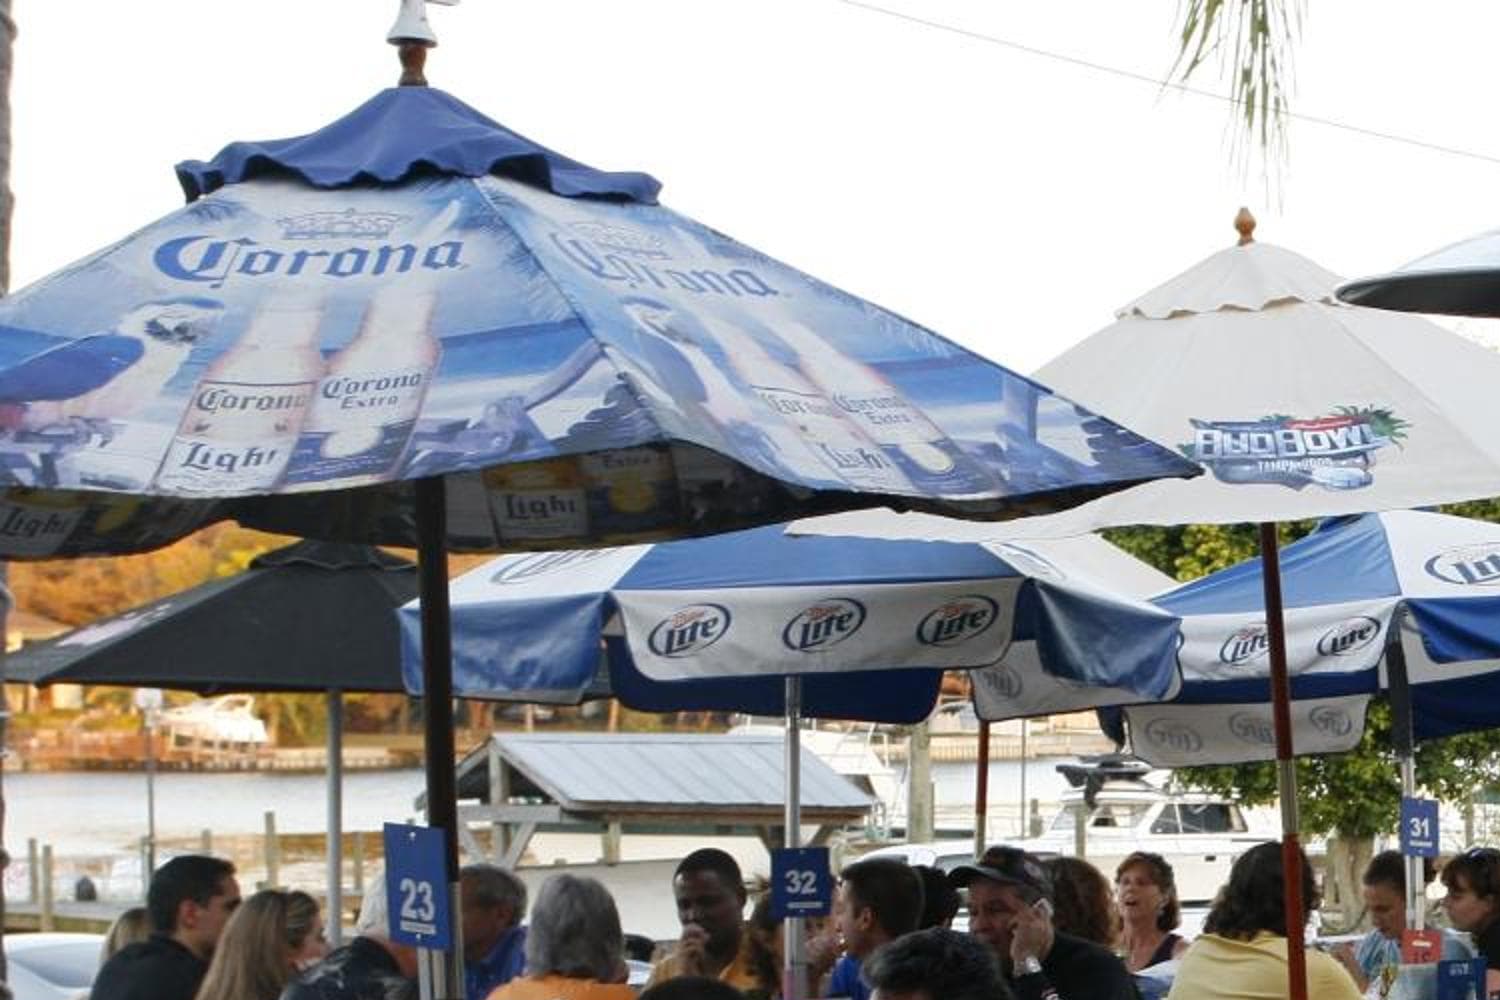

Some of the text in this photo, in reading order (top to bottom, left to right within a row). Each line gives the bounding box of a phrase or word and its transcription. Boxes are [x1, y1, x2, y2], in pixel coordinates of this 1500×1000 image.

[153, 234, 466, 288] Corona
[321, 373, 422, 400] Corona
[181, 441, 276, 472] Light
[664, 617, 719, 655] Lite
[800, 612, 854, 649] Lite
[933, 610, 990, 643] Lite
[1330, 625, 1373, 653] Lite
[1409, 818, 1430, 837] 31
[785, 869, 817, 895] 32
[400, 878, 435, 922] 23
